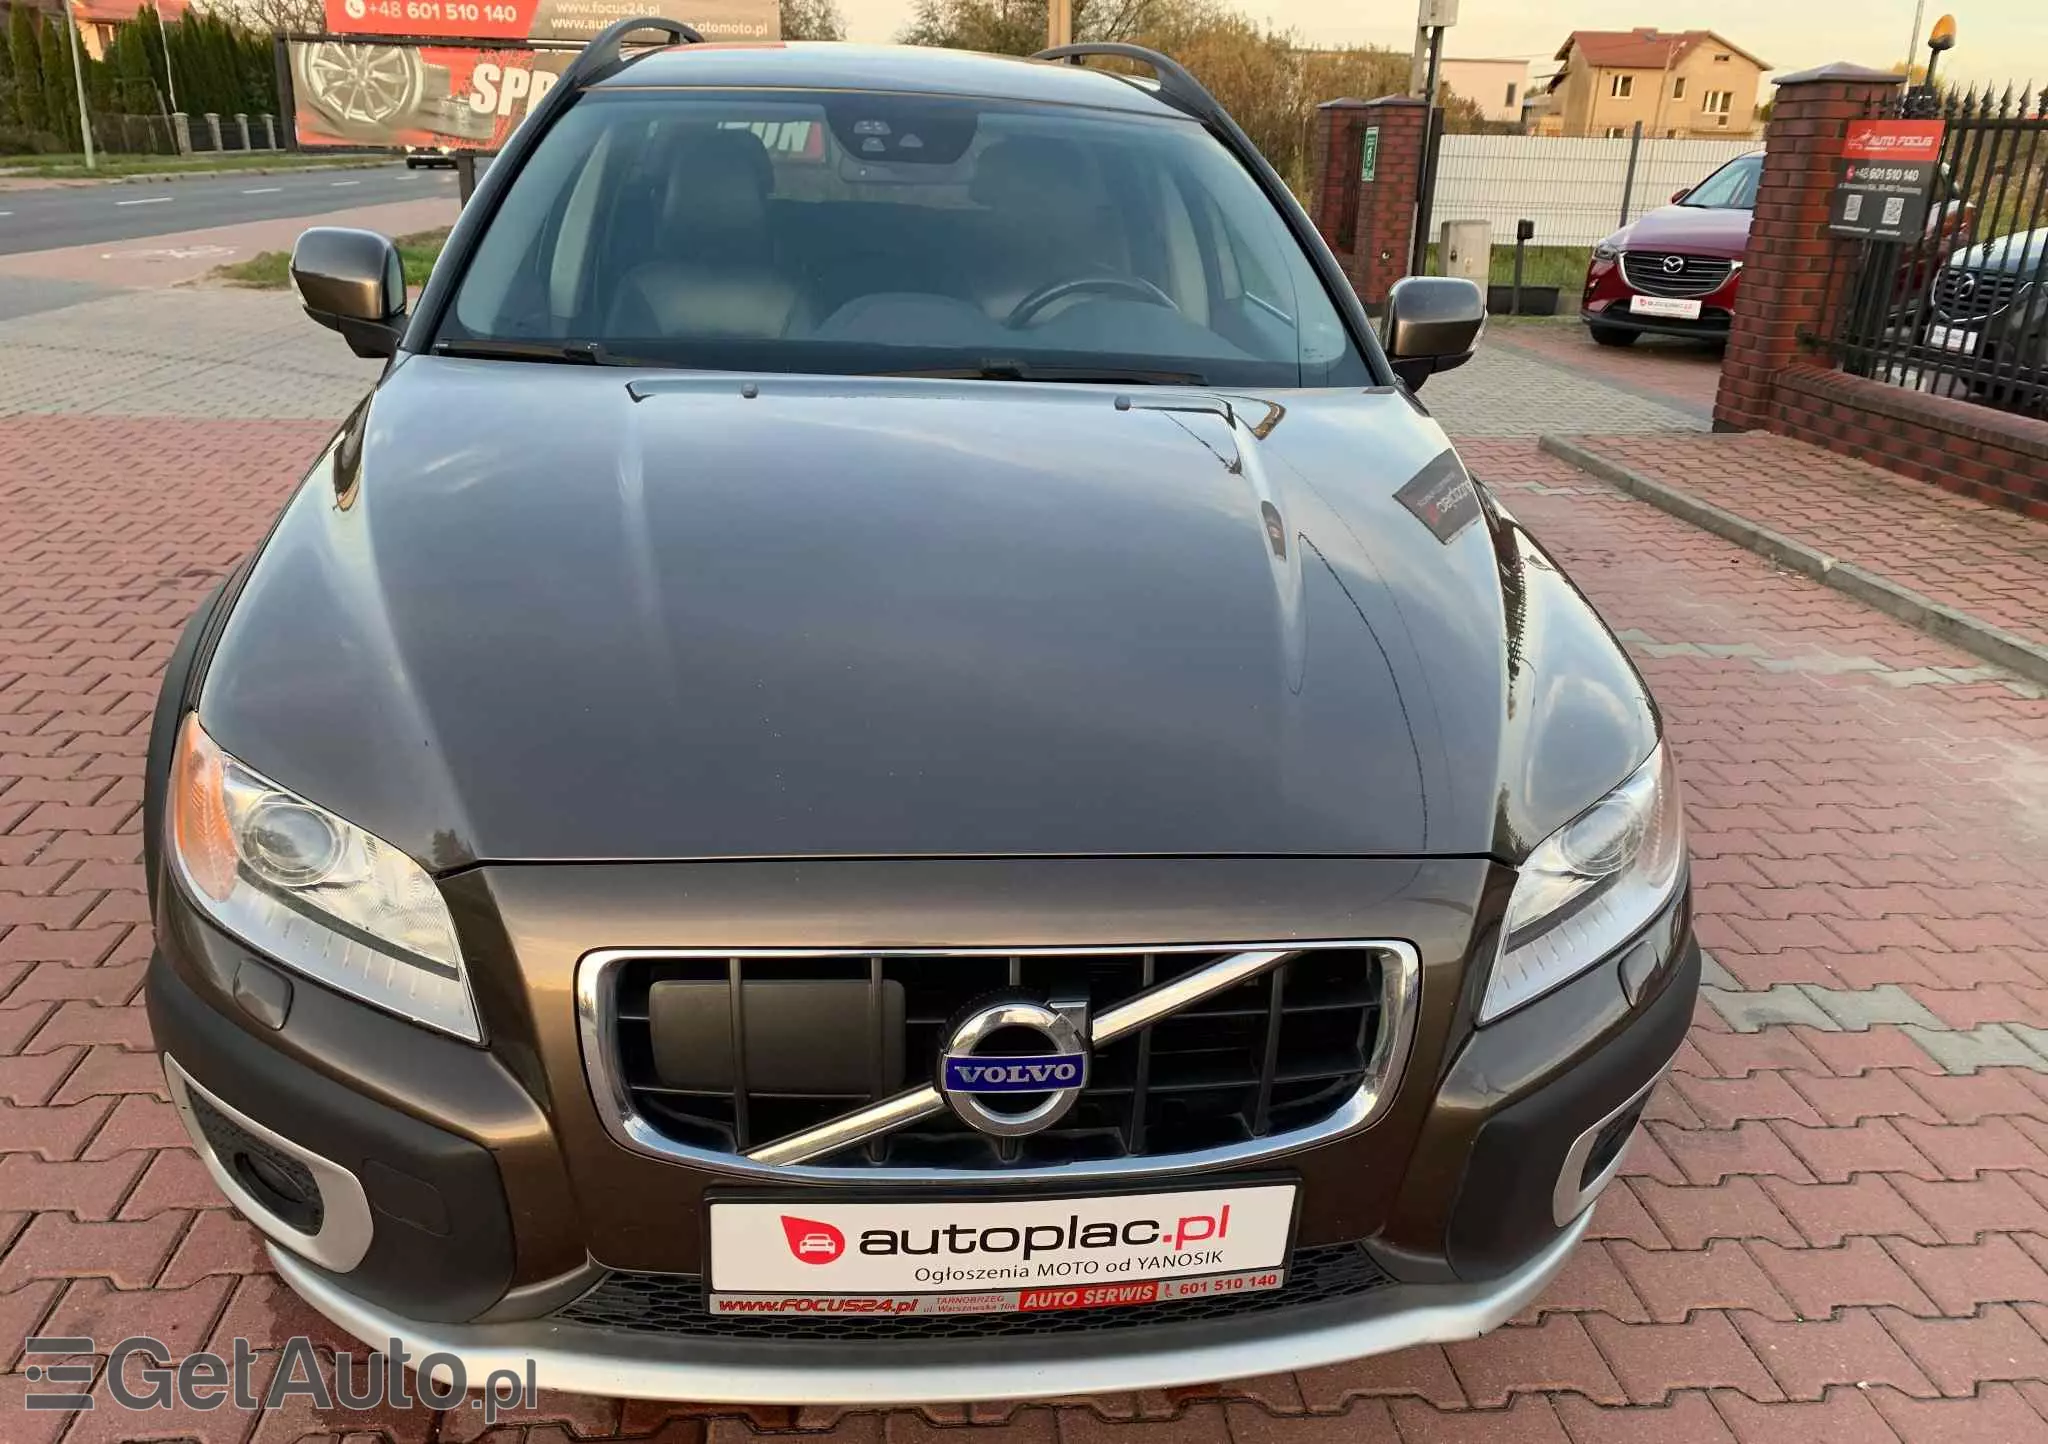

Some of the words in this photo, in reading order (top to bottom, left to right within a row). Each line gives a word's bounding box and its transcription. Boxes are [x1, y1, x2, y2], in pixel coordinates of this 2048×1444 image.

[369, 3, 401, 18] +48
[407, 3, 440, 20] 601
[446, 4, 479, 21] 510
[484, 5, 517, 22] 140
[555, 2, 661, 17] www.focus24.pl
[1868, 135, 1895, 147] AUTO
[954, 1063, 1076, 1083] VOLVO
[859, 1205, 1230, 1261] autoplac.pl
[915, 1266, 1029, 1285] Ogłoszenia
[1037, 1260, 1099, 1278] MOTO
[1105, 1259, 1131, 1272] od
[1138, 1249, 1224, 1270] YANOSIK
[1180, 1283, 1207, 1295] 601
[1214, 1279, 1243, 1291] 510
[1249, 1274, 1277, 1286] 140
[1024, 1291, 1077, 1308] AUTO
[1083, 1285, 1153, 1305] SERWIS
